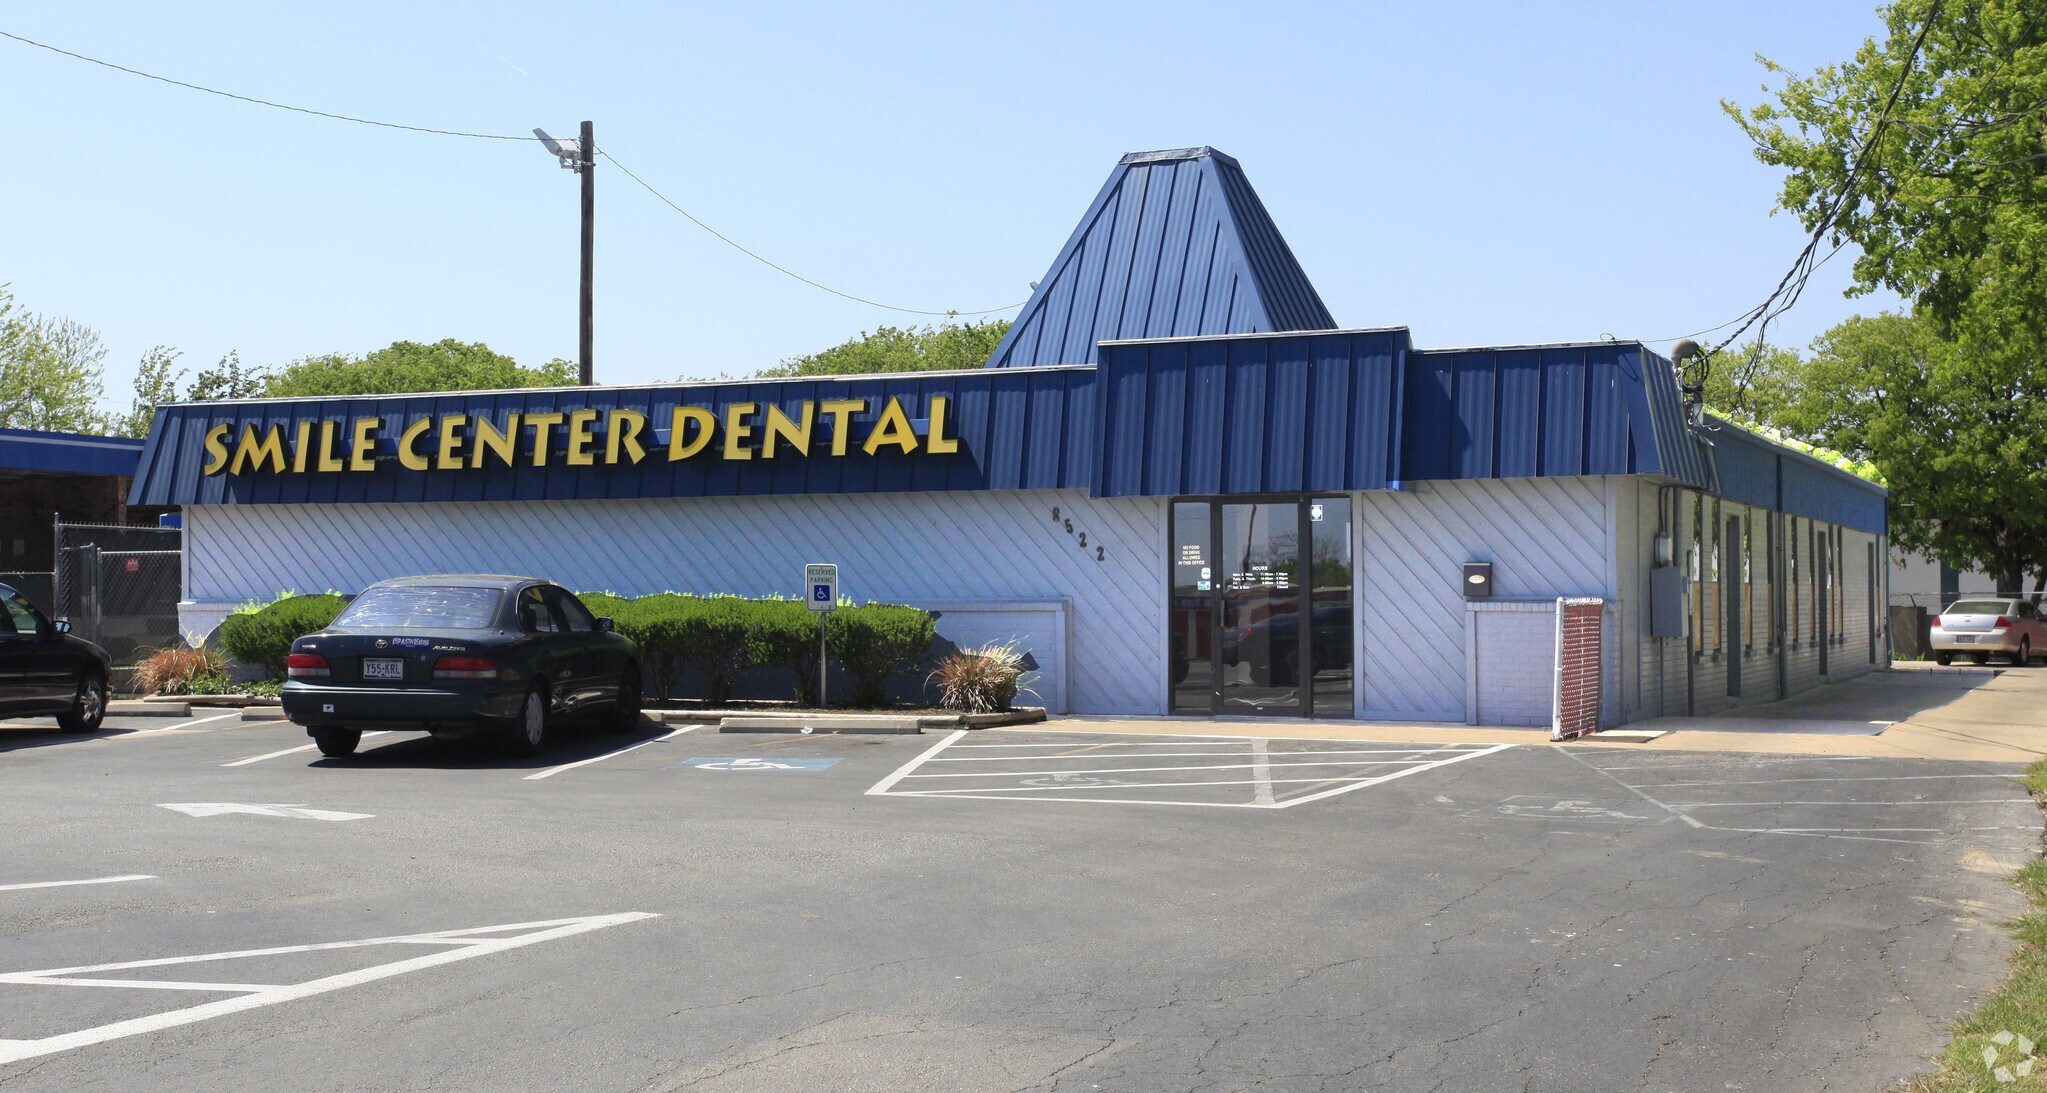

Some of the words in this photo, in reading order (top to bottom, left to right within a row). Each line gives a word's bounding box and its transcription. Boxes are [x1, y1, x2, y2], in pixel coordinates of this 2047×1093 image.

[204, 416, 383, 477] SMILE
[398, 408, 648, 471] CENTER
[667, 394, 959, 463] DENTAL
[1052, 506, 1105, 562] 8522
